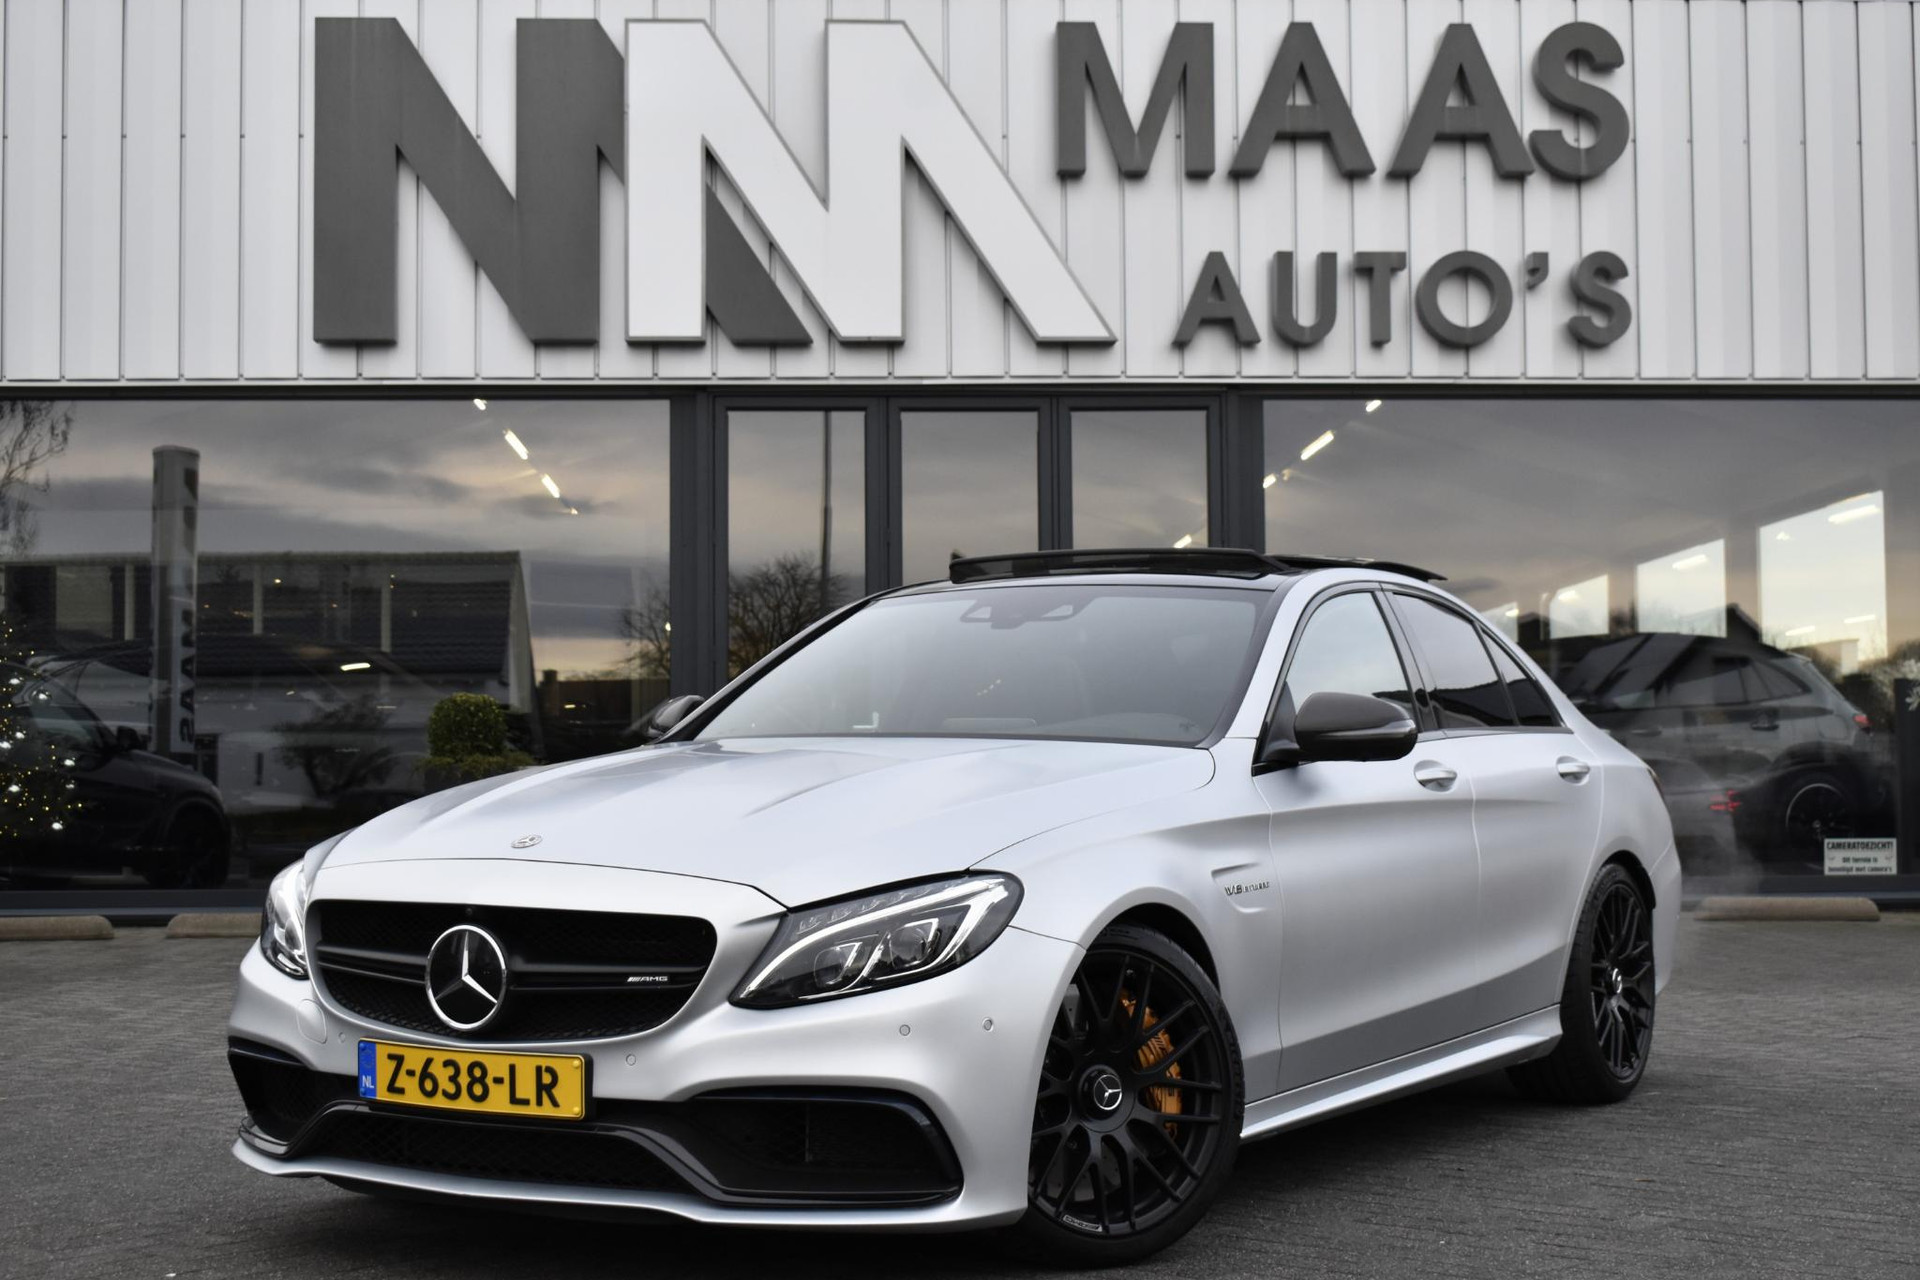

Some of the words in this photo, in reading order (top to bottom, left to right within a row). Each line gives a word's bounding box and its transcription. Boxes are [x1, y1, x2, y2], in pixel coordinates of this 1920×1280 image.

[1056, 21, 1630, 182] MAAS
[1171, 250, 1632, 347] AUTO'S
[362, 1075, 374, 1089] NL
[386, 1053, 560, 1108] Z-638-LR
